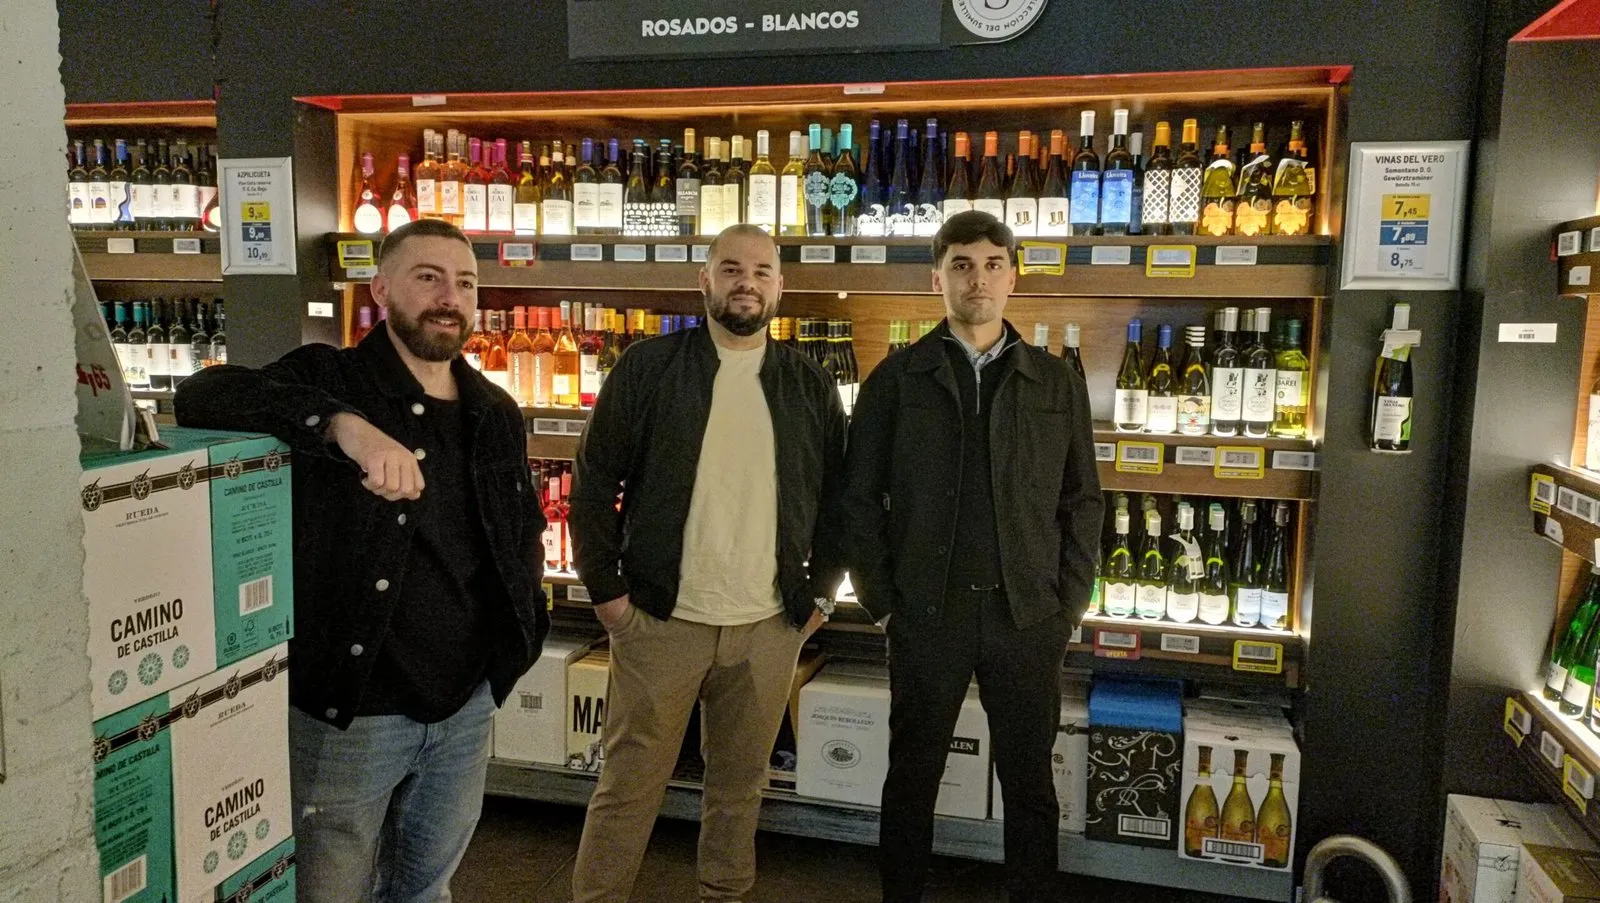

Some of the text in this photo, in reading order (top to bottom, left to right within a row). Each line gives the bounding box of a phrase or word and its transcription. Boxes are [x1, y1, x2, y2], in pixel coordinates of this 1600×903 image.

[641, 16, 738, 37] ROSADOS
[762, 11, 860, 32] BLANCOS
[985, 24, 1000, 32] DEL
[1403, 155, 1420, 164] DEL
[1421, 154, 1445, 164] VERO
[1383, 174, 1434, 182] Gewürztraminer
[1394, 201, 1417, 217] 7,45
[1390, 252, 1414, 269] 8,75
[224, 484, 248, 497] CAMINO
[255, 476, 283, 490] CASTILLA
[125, 506, 160, 521] RUEDA
[110, 598, 184, 643] CAMINO
[117, 625, 179, 659] DE CASTILLA
[217, 701, 246, 720] RUEDA
[128, 744, 160, 767] CASTILLA
[204, 777, 265, 828] CAMINO
[210, 802, 261, 842] DE CASTILLA
